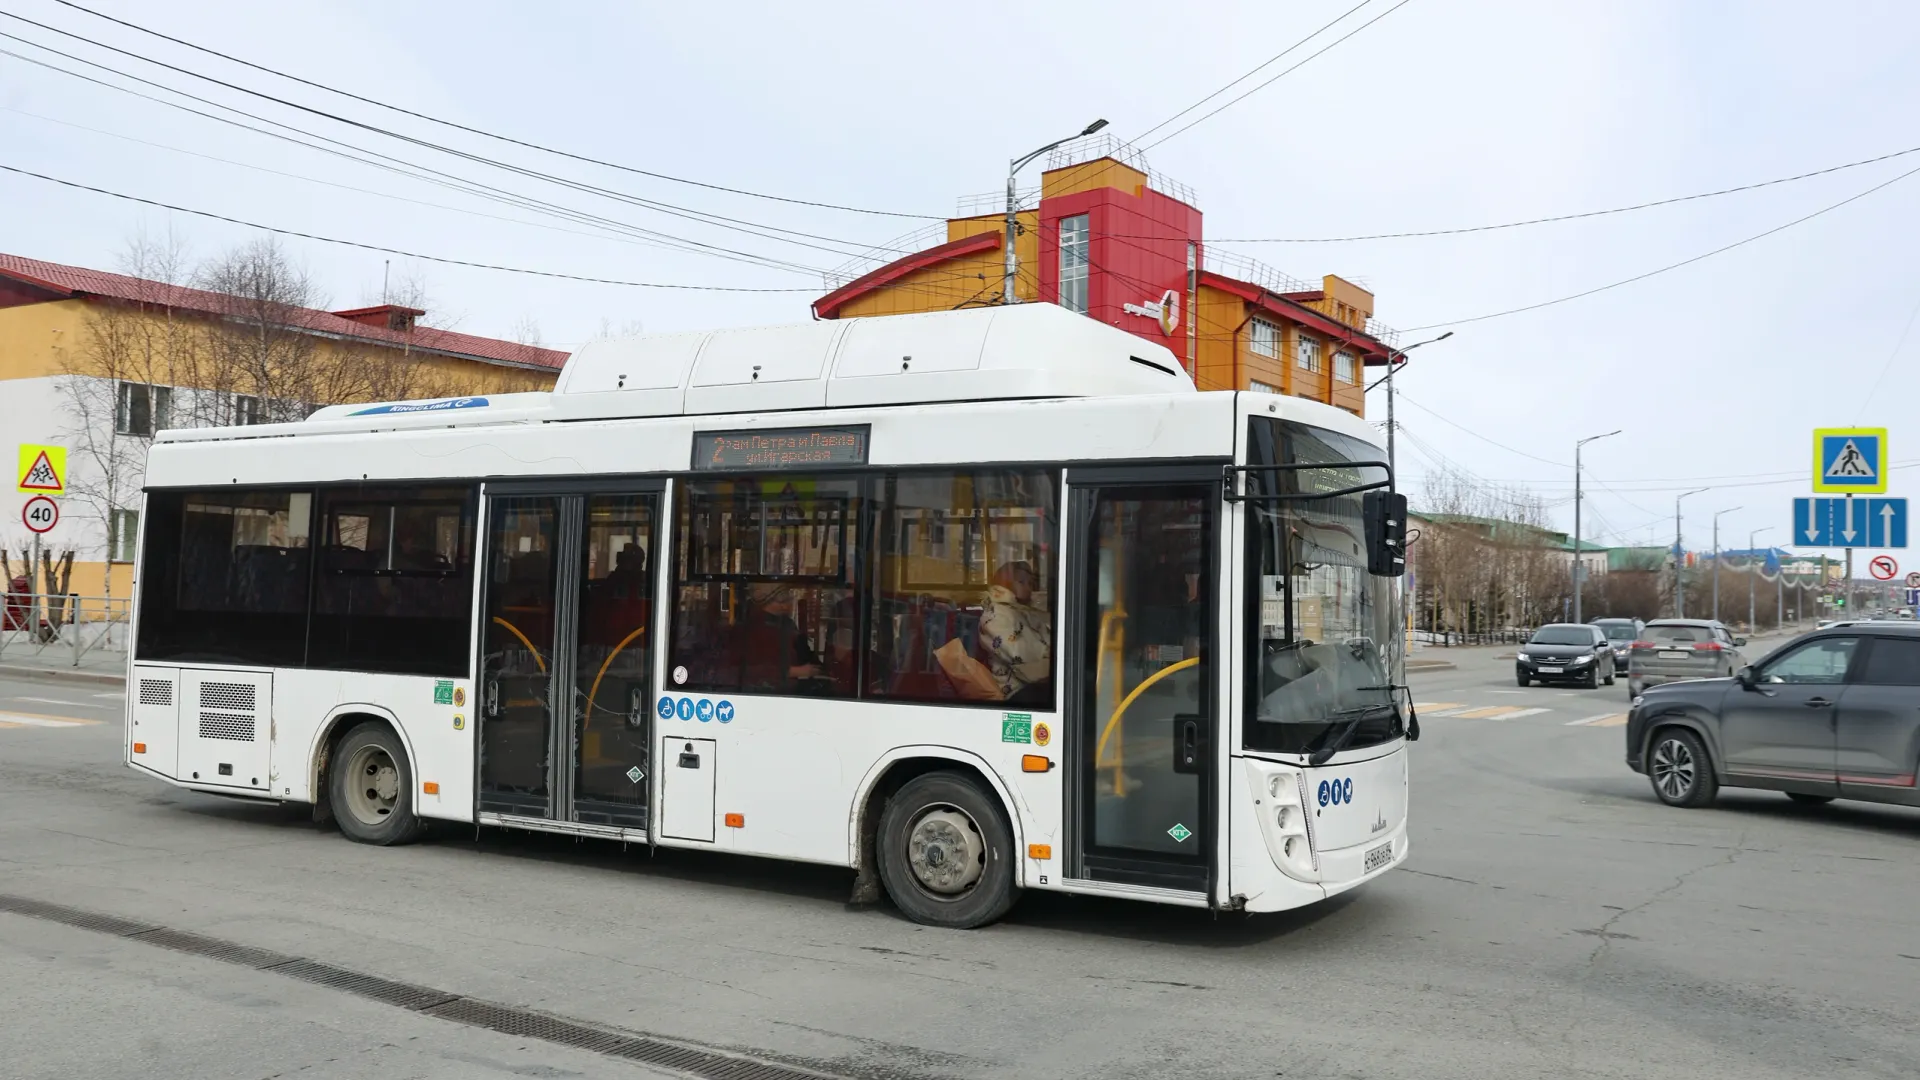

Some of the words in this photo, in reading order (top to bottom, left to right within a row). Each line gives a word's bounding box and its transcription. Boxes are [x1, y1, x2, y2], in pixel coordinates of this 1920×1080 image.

[752, 436, 796, 449] Петра
[810, 433, 855, 447] Павла
[713, 437, 725, 463] 2
[30, 507, 51, 522] 40
